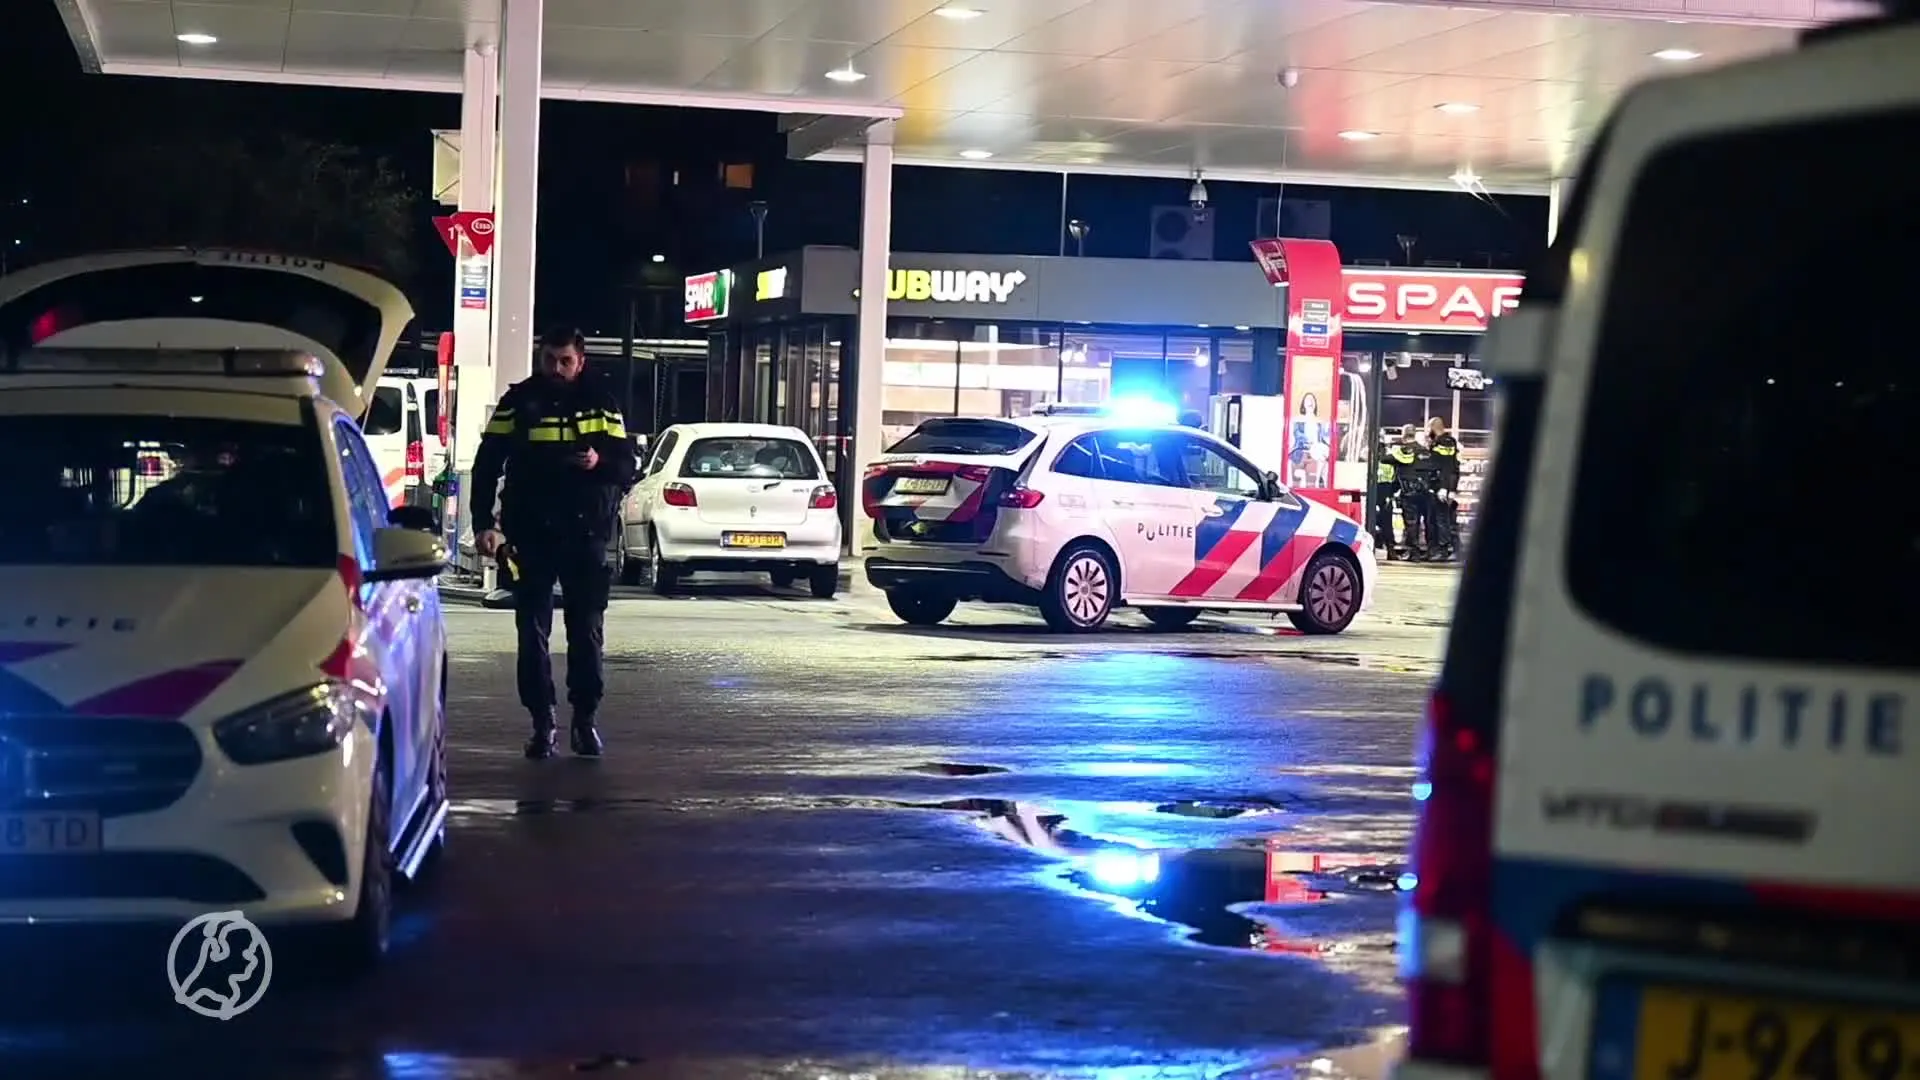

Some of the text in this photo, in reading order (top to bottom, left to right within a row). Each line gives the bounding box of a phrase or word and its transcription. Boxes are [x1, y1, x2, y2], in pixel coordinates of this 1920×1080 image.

[853, 269, 1026, 302] UBWAY
[1577, 672, 1904, 756] POLITIE
[0, 816, 88, 850] 8-TD
